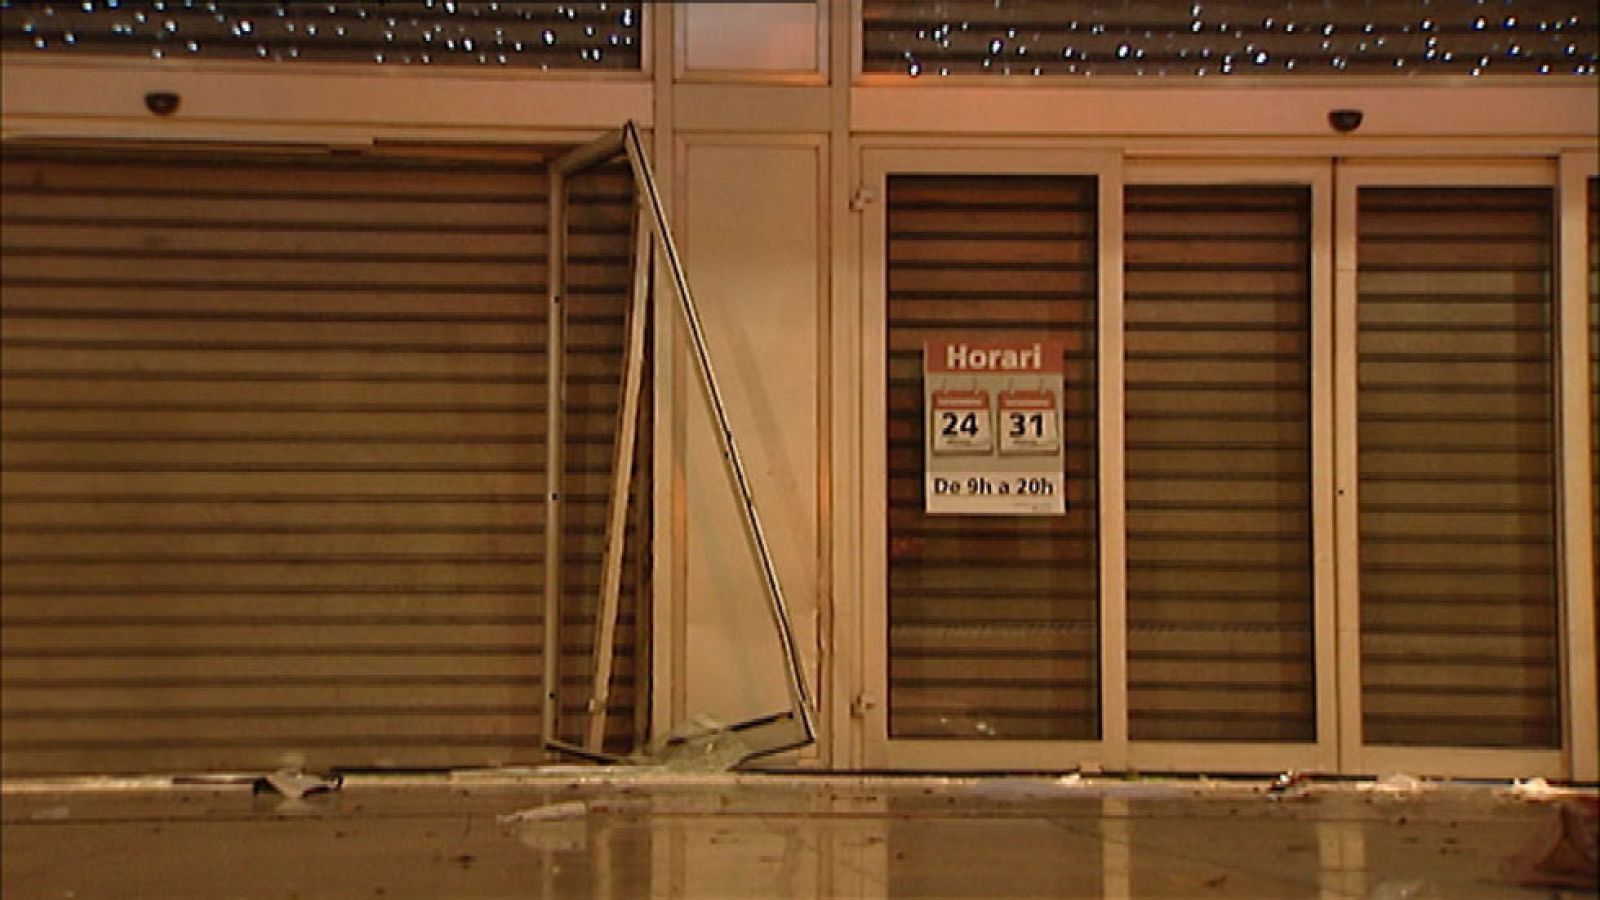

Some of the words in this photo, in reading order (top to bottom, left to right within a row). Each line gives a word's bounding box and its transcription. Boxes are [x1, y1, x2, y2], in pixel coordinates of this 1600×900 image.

[946, 342, 1041, 370] Horari
[942, 412, 978, 438] 24
[1009, 412, 1043, 438] 31
[934, 478, 960, 494] De
[967, 478, 992, 494] 9h
[998, 481, 1010, 494] a
[1017, 478, 1053, 494] 20h
